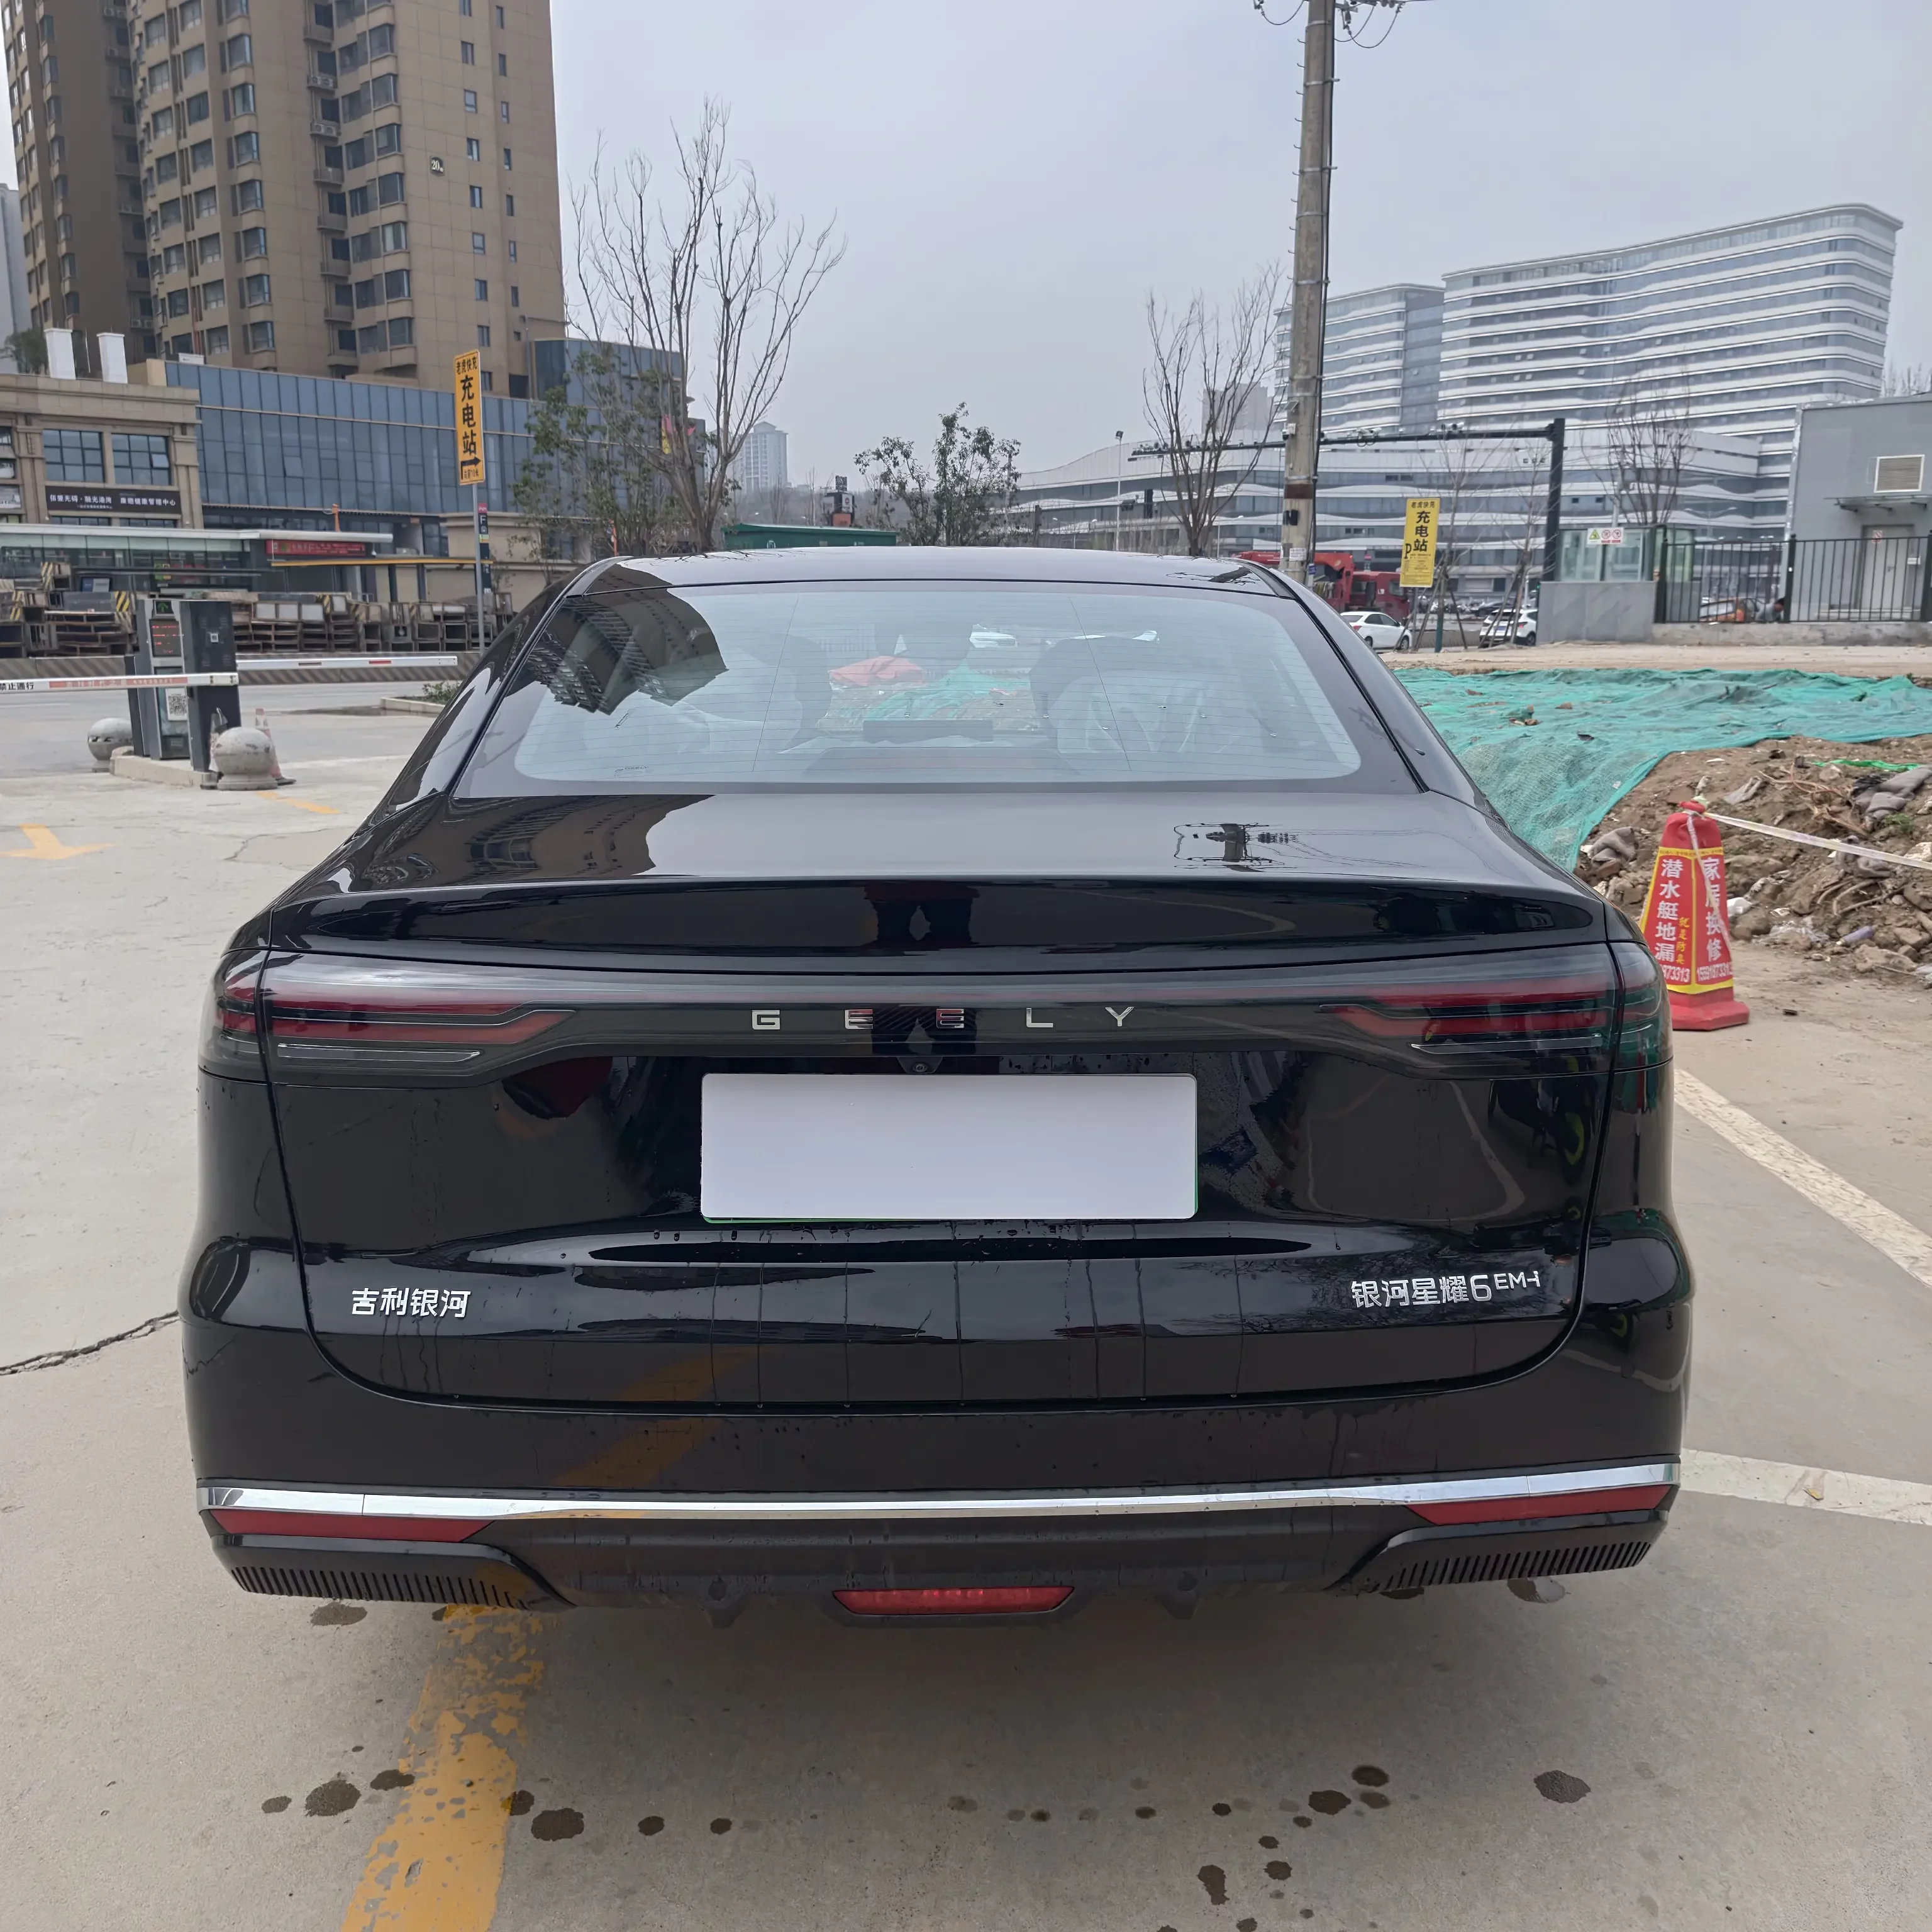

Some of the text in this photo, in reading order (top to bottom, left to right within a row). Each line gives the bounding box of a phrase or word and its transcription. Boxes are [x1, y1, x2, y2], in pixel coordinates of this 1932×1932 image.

[456, 357, 478, 375] 老虎快充
[460, 374, 477, 455] 充电站
[1413, 510, 1431, 552] 充电站
[0, 682, 35, 691] 禁止通行
[1654, 858, 1684, 963] 潜水艇地漏
[752, 1006, 1135, 1030] GEELY
[352, 1287, 471, 1318] 吉利银河
